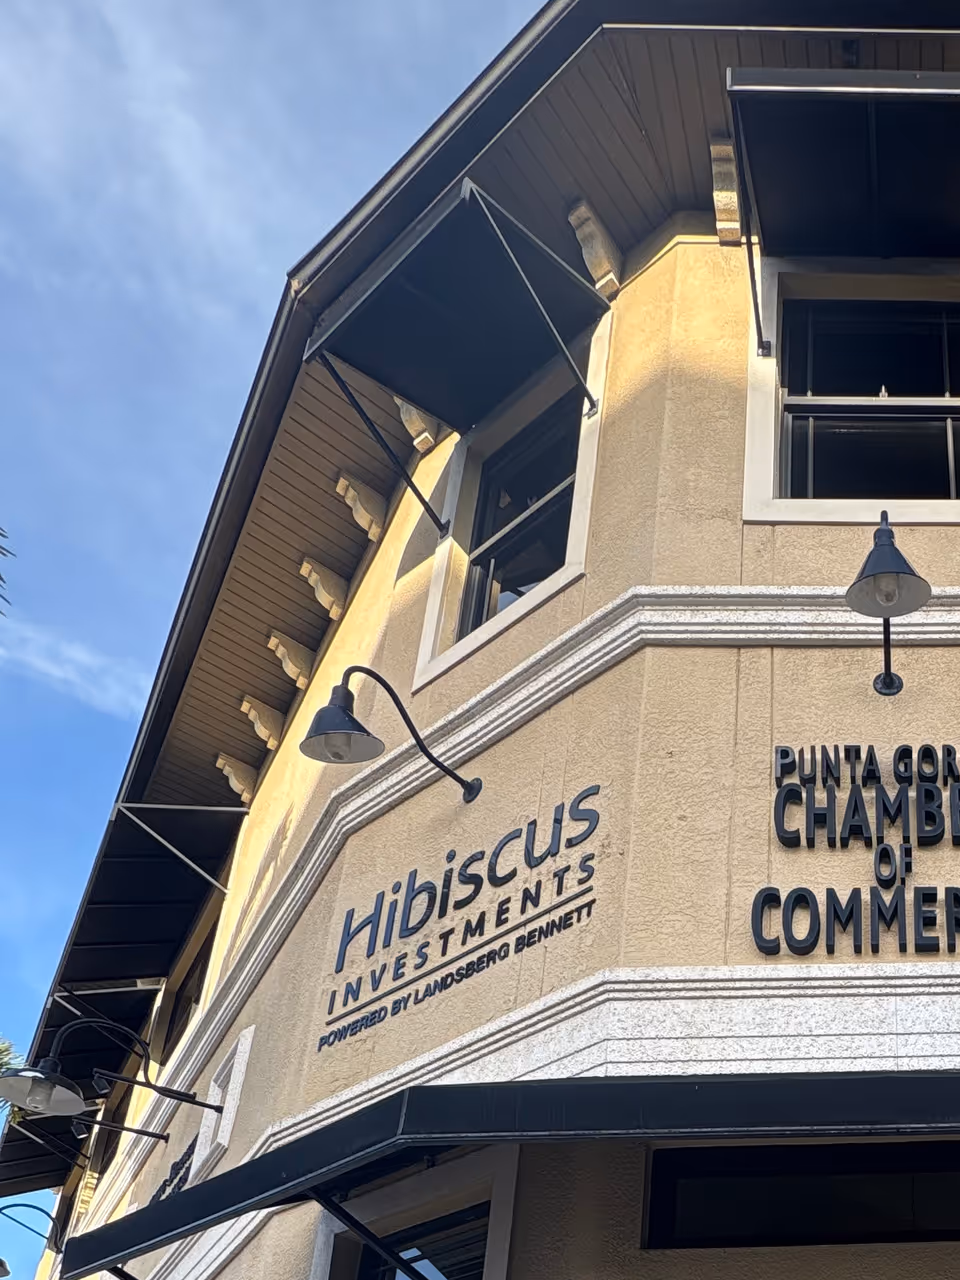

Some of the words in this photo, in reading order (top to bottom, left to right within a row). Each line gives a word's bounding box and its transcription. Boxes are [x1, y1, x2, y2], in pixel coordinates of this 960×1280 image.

[775, 744, 881, 788] PUNTA
[326, 853, 595, 1015] INVESTMENTS
[334, 784, 600, 974] Hibiscus
[874, 843, 912, 890] OF
[317, 1006, 388, 1052] POWERED
[390, 992, 412, 1017] BY
[414, 942, 510, 1004] LANDSBERG
[514, 899, 596, 954] BENNETT
